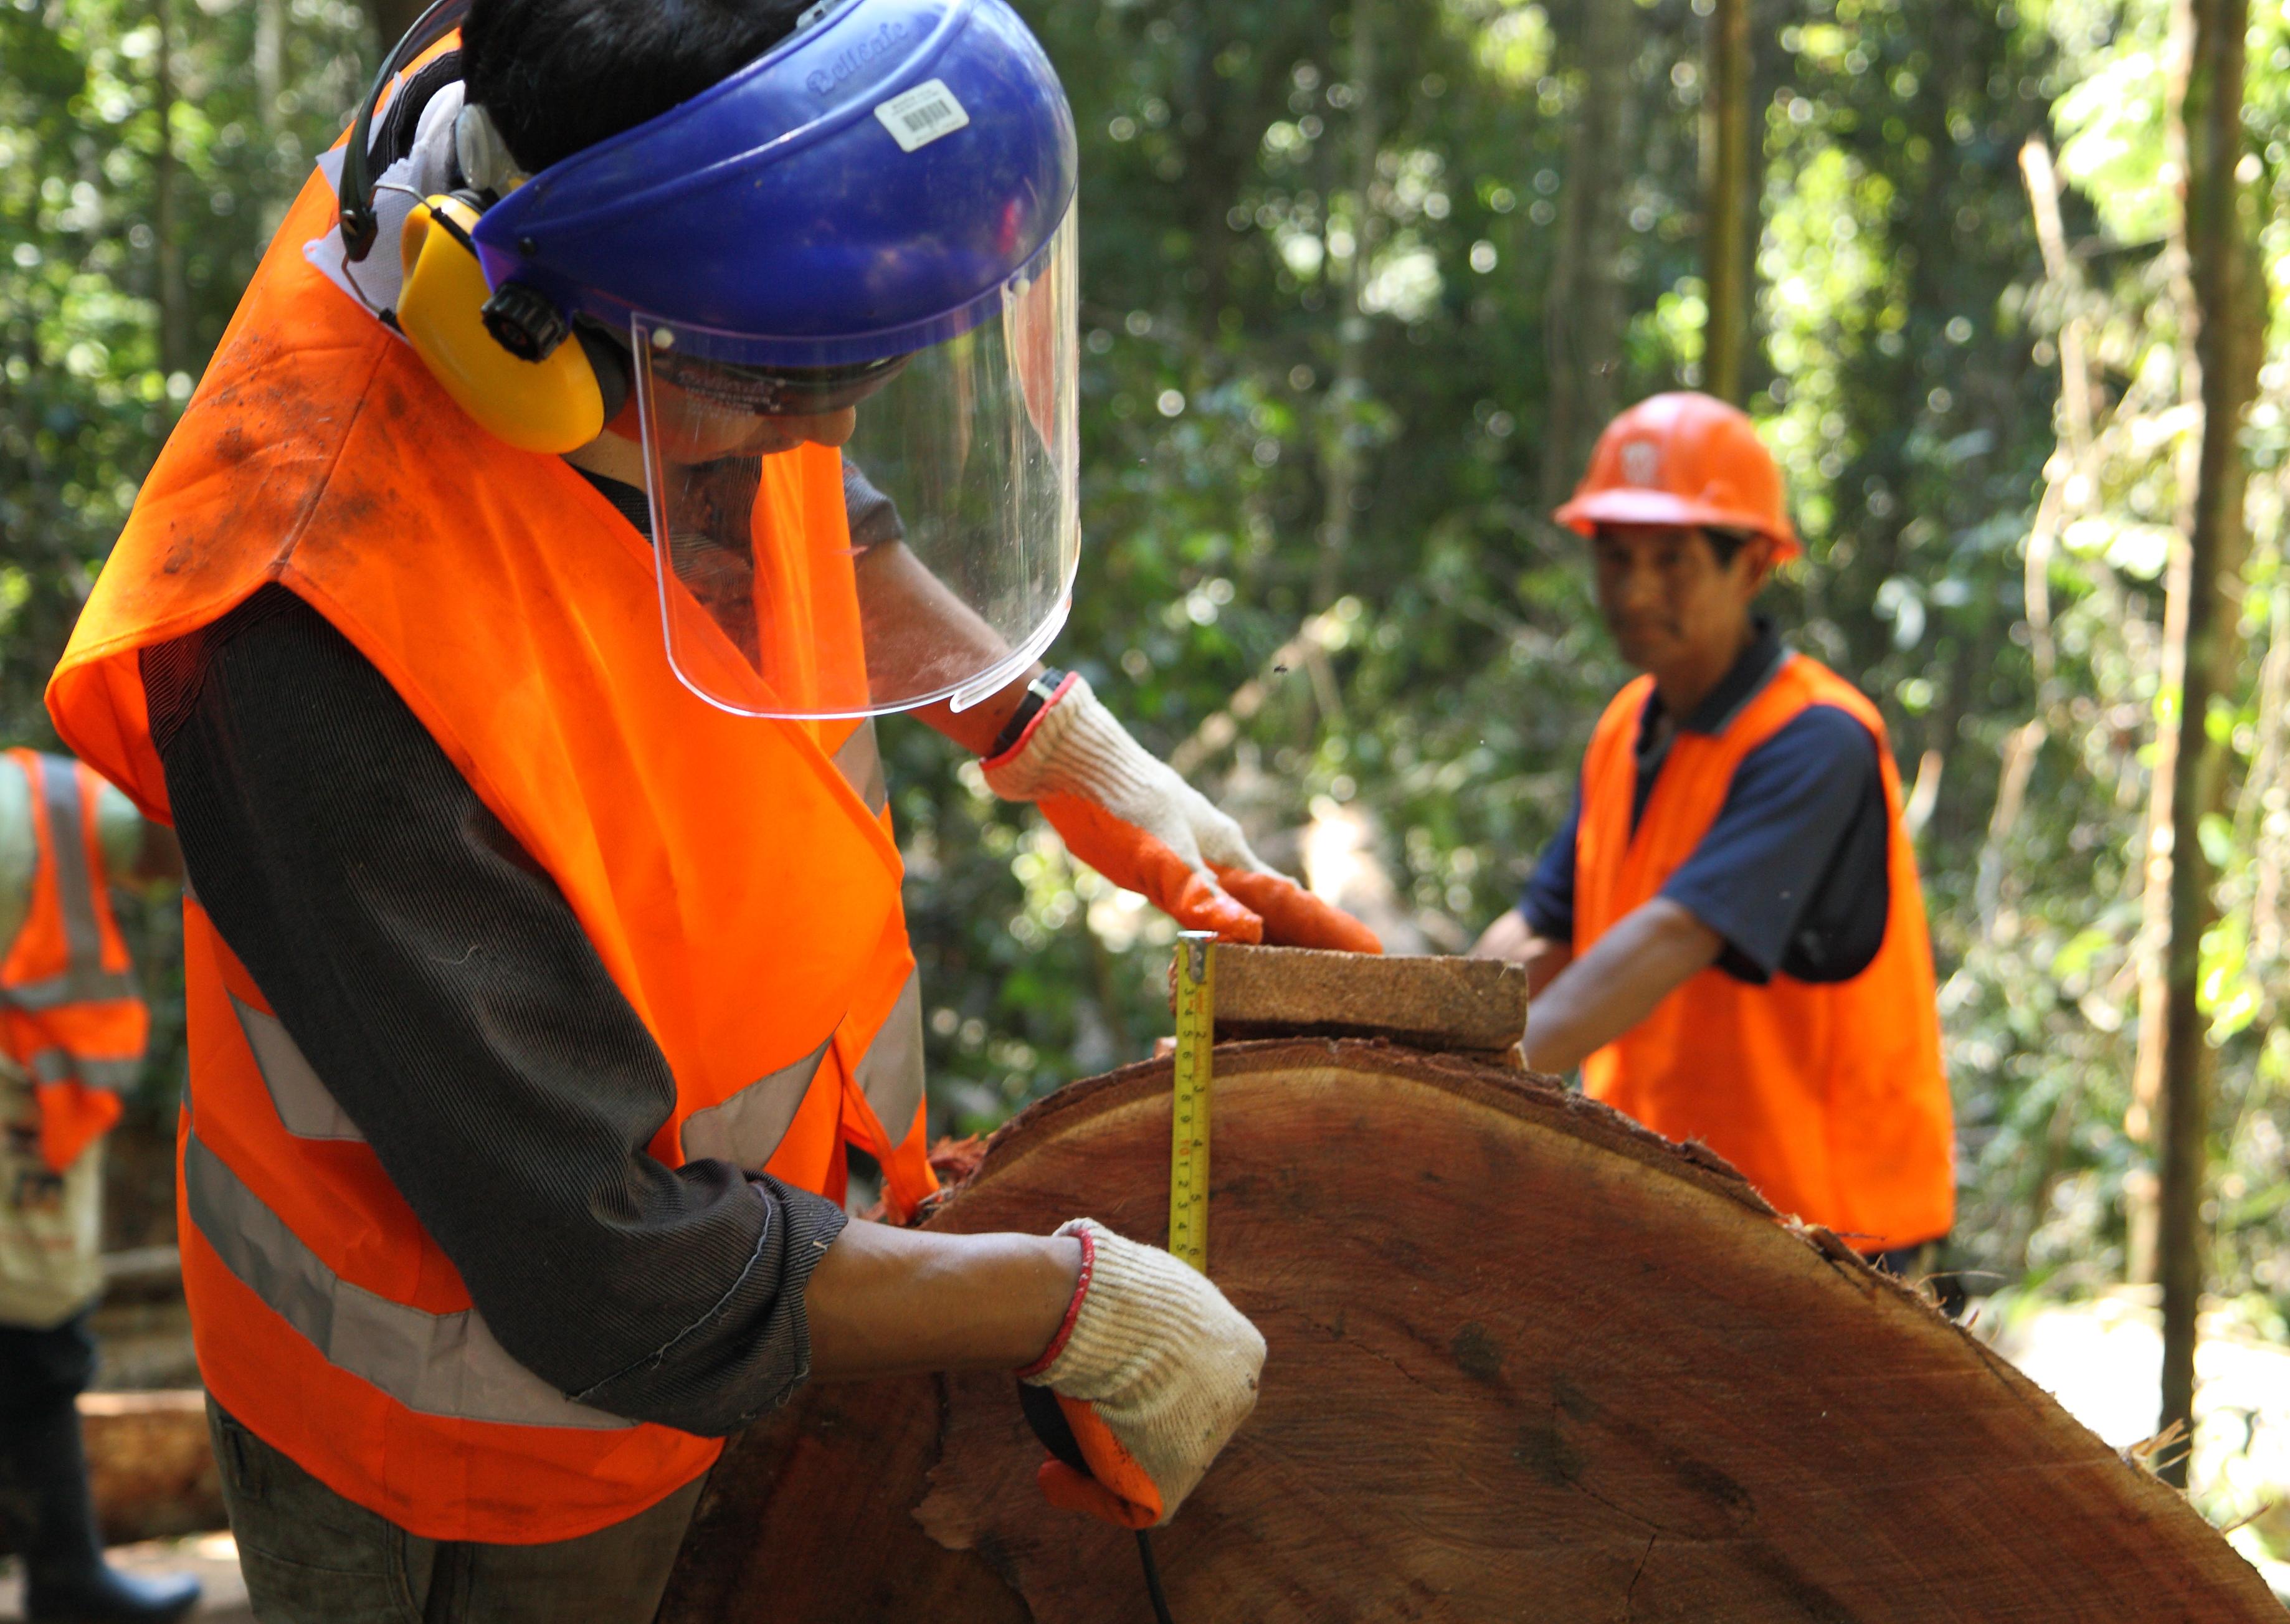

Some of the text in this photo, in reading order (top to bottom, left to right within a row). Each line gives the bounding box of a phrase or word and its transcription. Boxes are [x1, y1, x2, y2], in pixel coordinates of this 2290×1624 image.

[1194, 1085, 1205, 1093] 3
[1193, 1139, 1203, 1147] 4
[1179, 1140, 1190, 1156] 10
[1190, 1194, 1201, 1202] 5
[1189, 1248, 1199, 1256] 6
